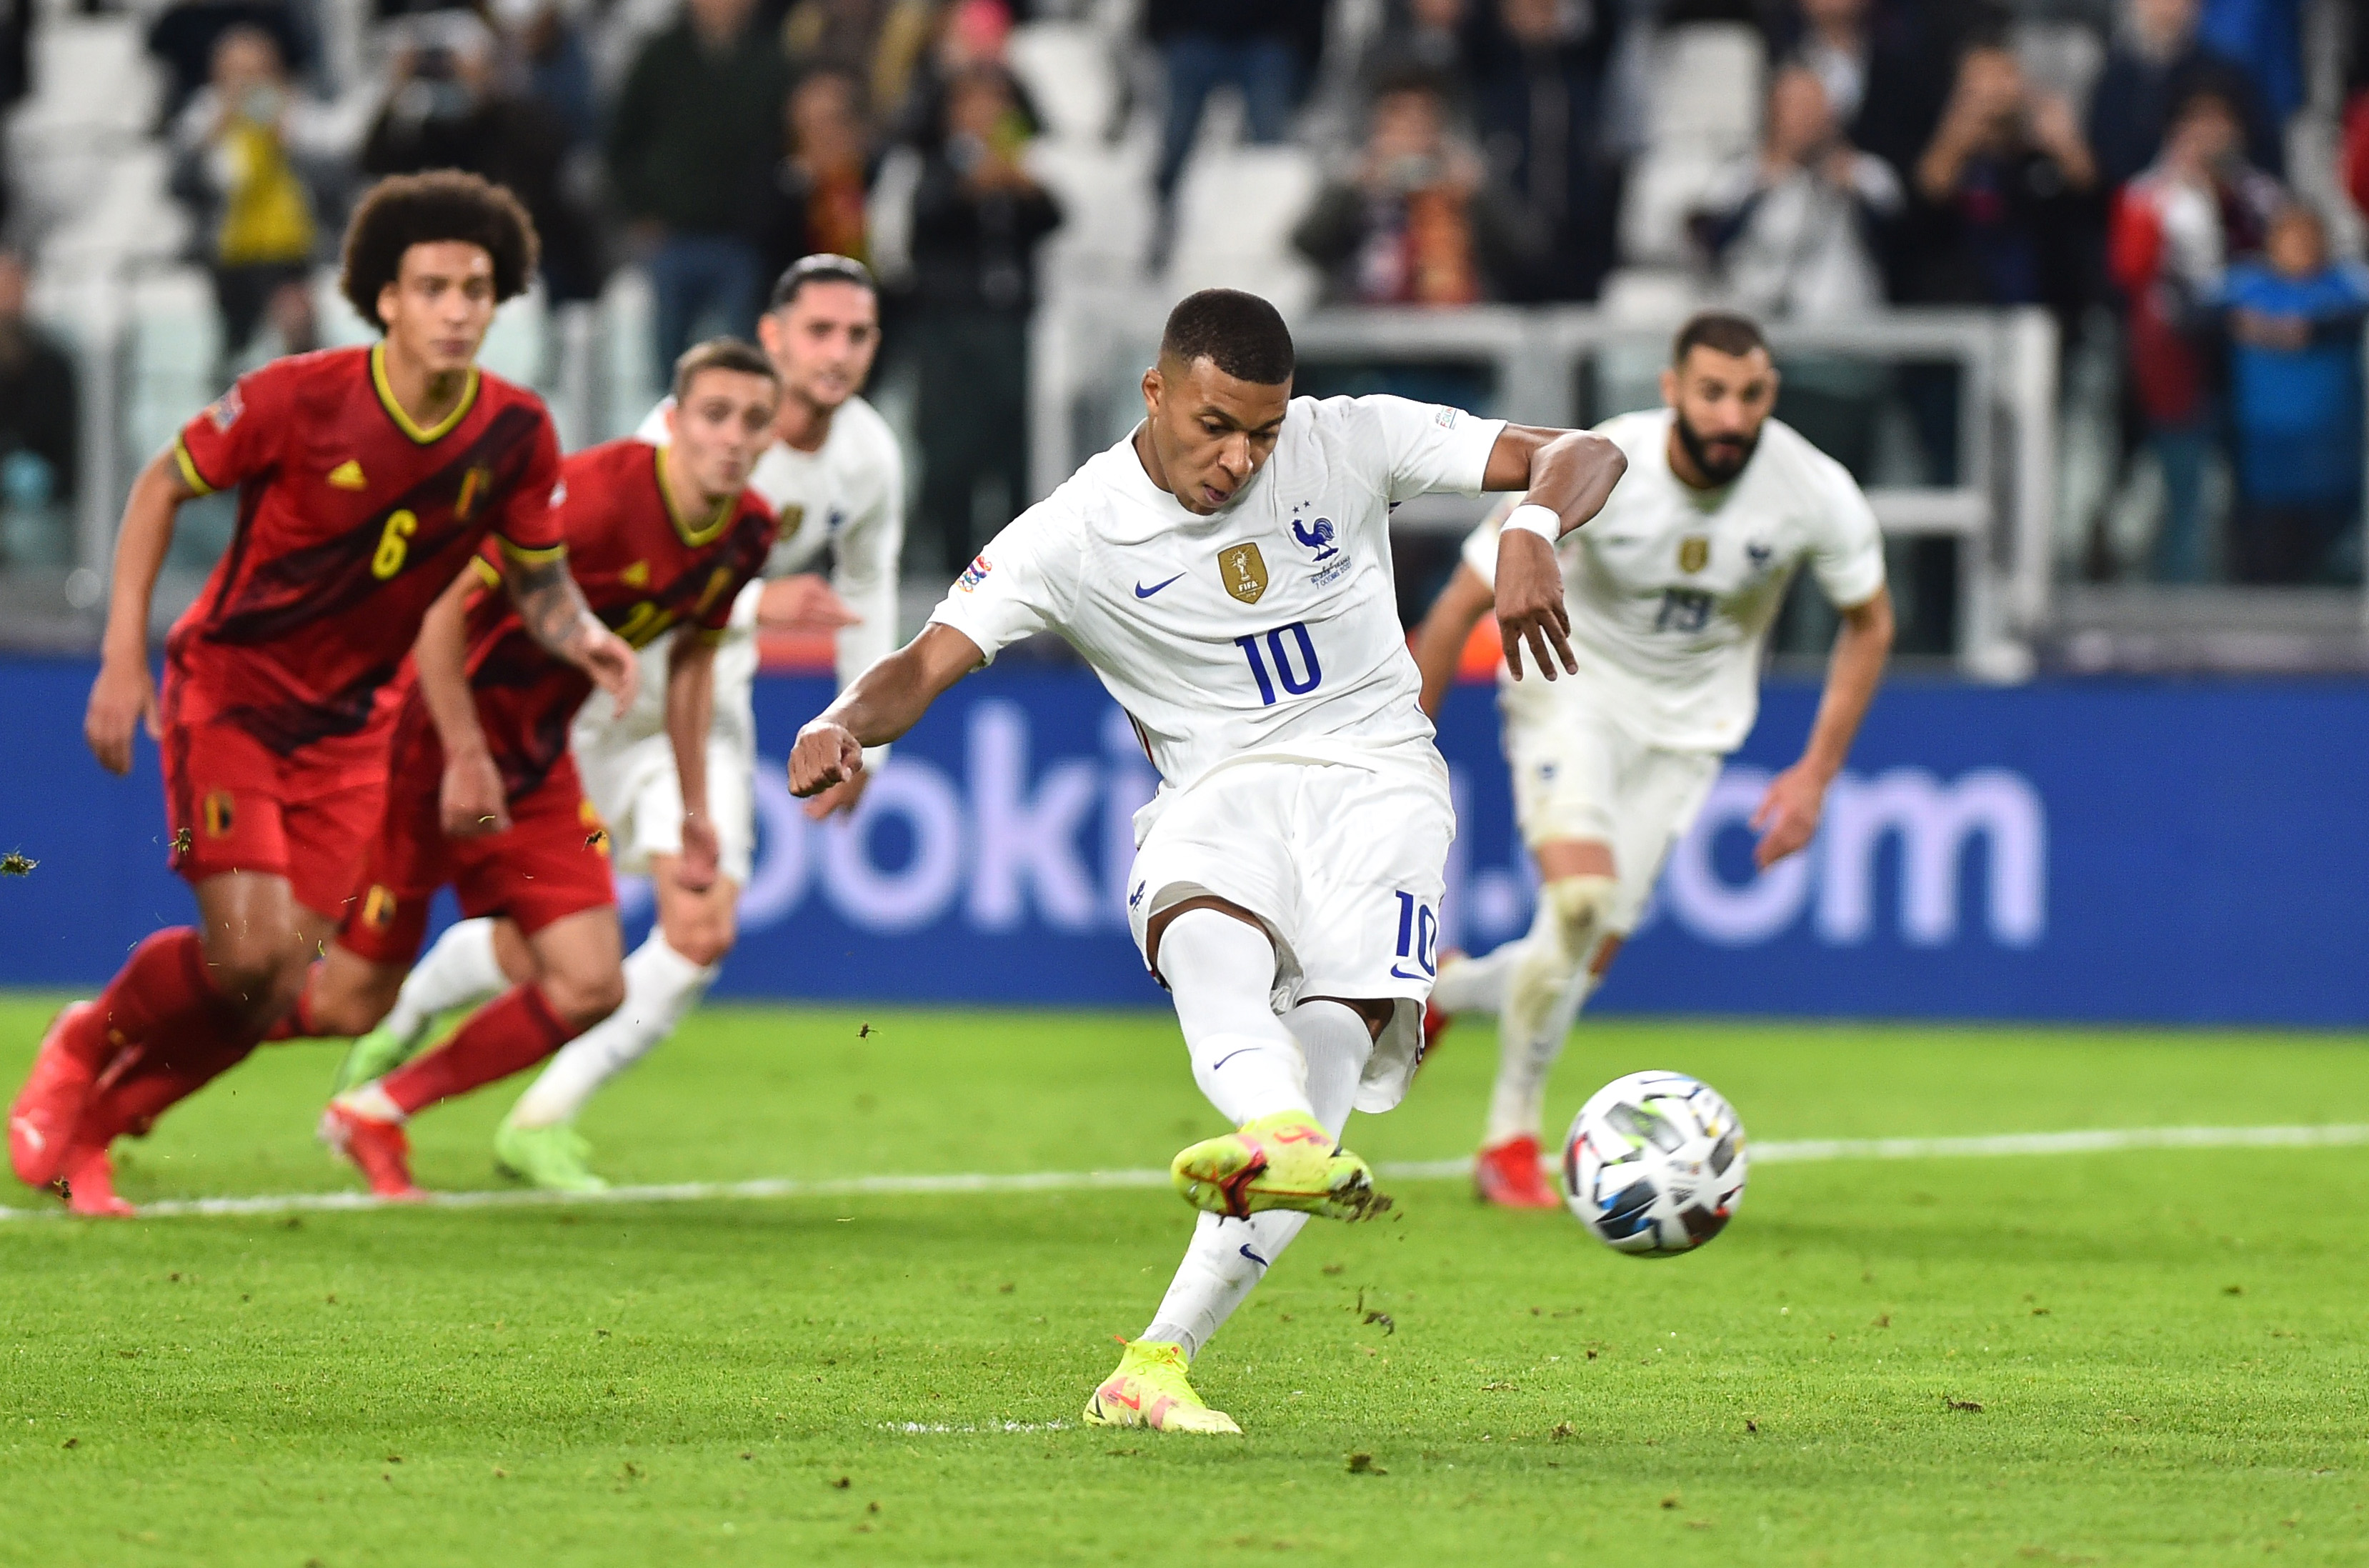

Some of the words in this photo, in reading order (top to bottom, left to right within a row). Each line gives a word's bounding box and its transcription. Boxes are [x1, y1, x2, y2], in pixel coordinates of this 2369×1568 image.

[371, 508, 417, 579] 6
[1238, 580, 1258, 591] FIFA
[1234, 620, 1322, 706] 10
[1395, 889, 1437, 978] 10
